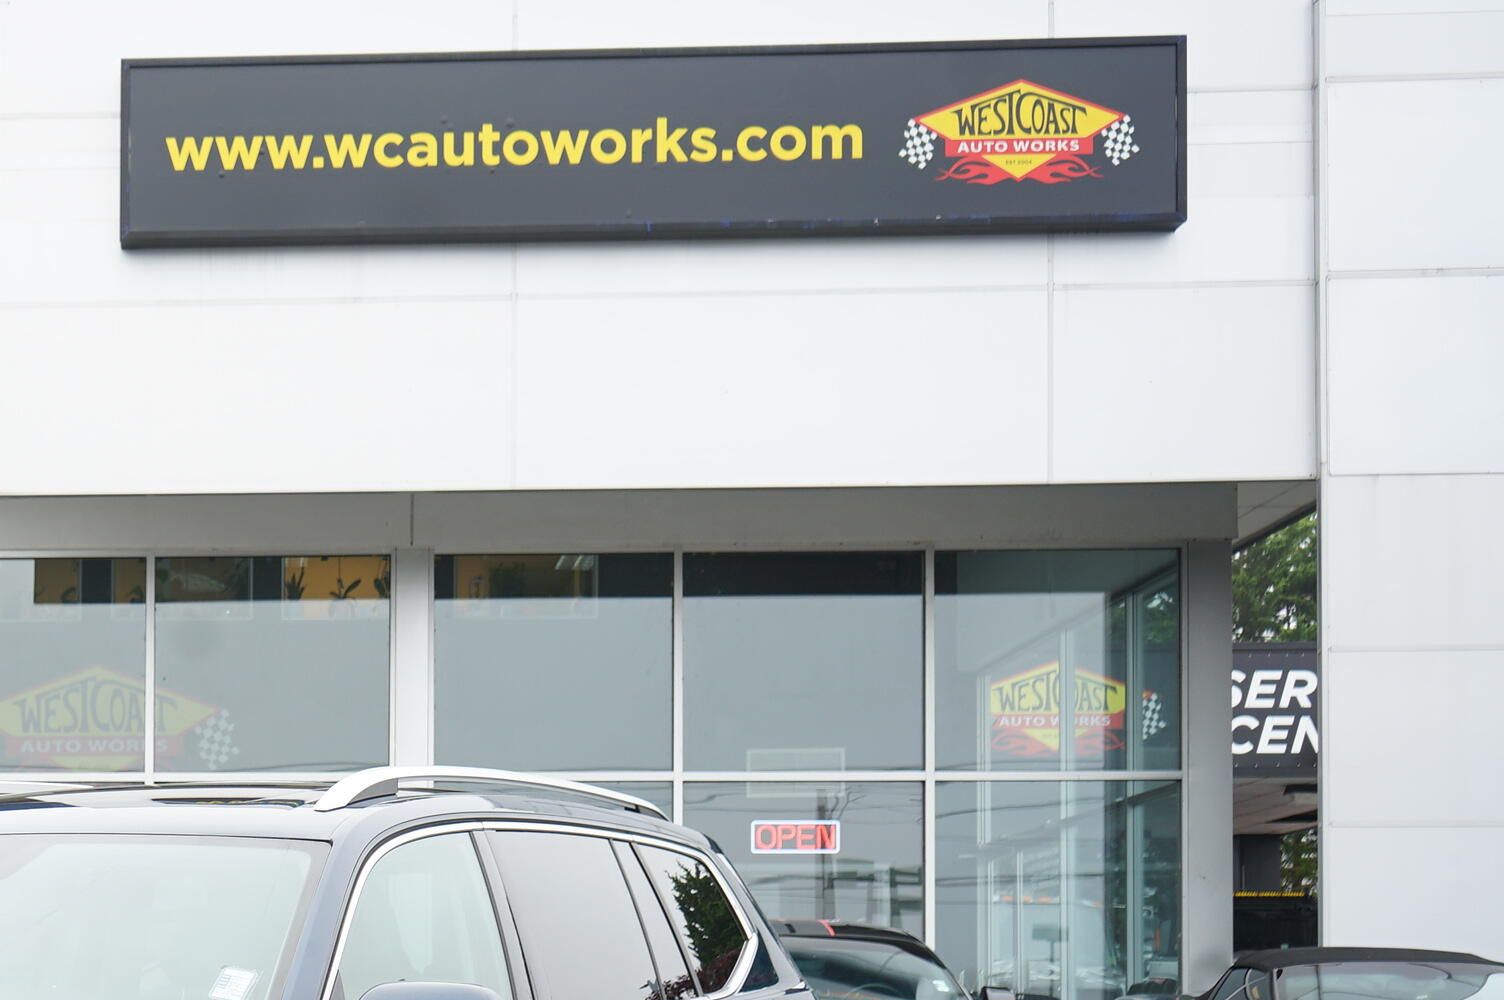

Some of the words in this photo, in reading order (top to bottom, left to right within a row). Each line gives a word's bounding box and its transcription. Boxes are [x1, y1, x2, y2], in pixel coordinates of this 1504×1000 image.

[165, 117, 864, 171] www.wcautoworks.com
[957, 140, 1004, 153] AUTO
[1013, 139, 1080, 152] WORKS
[998, 715, 1046, 728] AUTO
[20, 739, 81, 753] AUTO
[756, 823, 836, 850] OPEN
